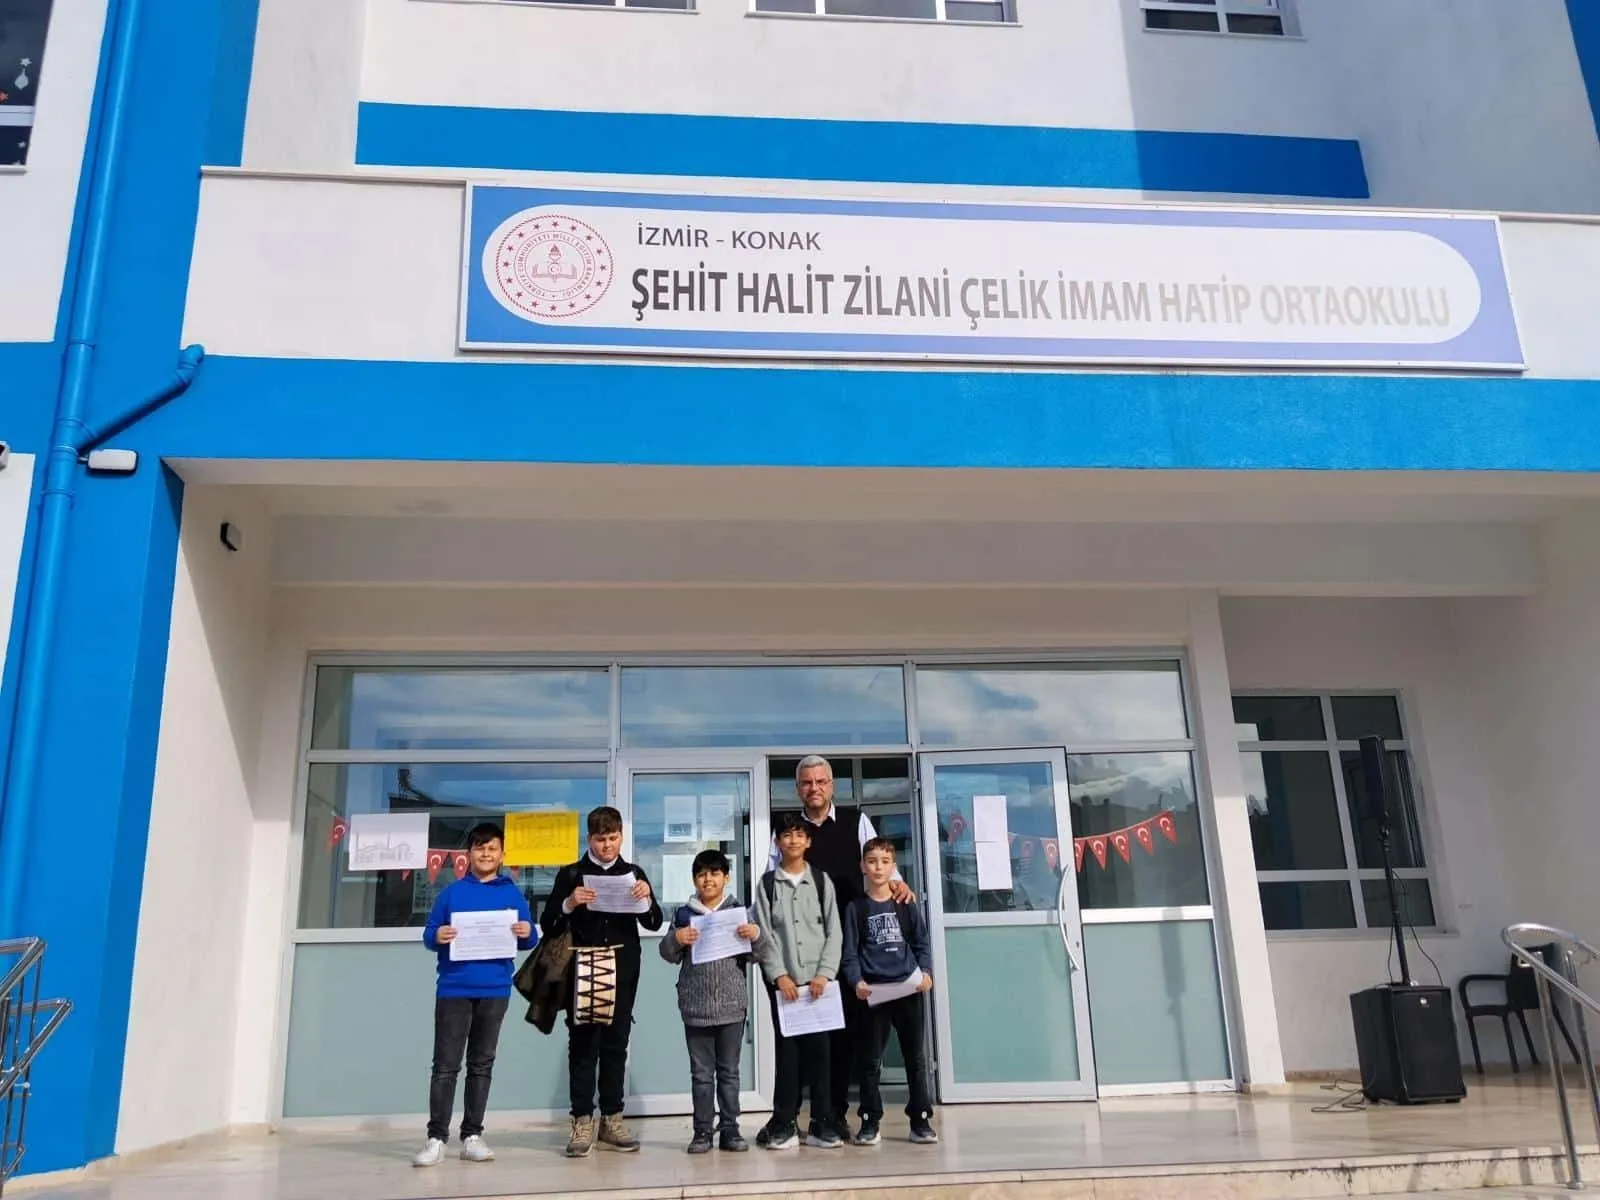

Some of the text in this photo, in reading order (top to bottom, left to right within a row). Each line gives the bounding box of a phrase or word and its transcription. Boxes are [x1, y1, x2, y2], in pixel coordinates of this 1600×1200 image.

[637, 222, 710, 247] İZMİR
[731, 229, 822, 251] KONAK
[631, 261, 1451, 331] ŞEHİT HALİT ZİLANİ ÇELİK İMAM HATİP ORTAOKULU
